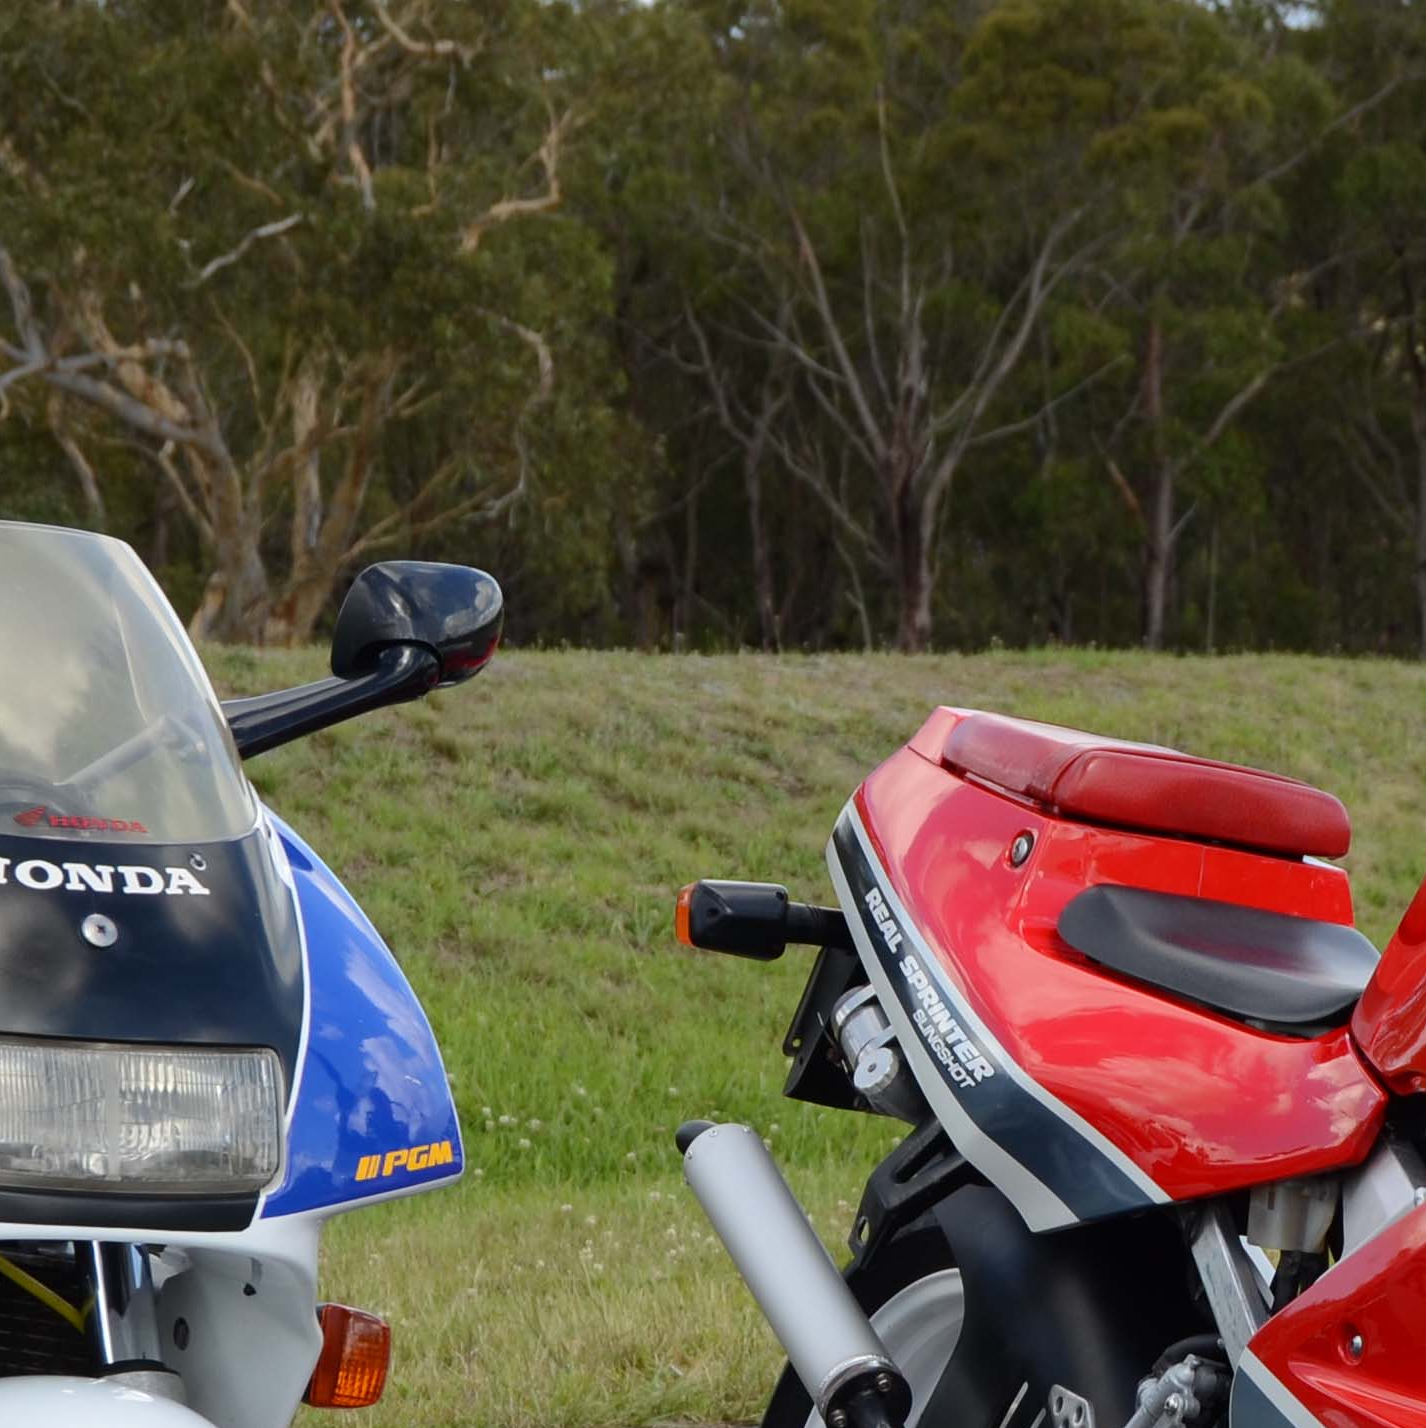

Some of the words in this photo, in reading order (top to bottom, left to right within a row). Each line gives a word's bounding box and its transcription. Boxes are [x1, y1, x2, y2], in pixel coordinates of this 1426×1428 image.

[47, 814, 149, 834] HONDA
[865, 887, 904, 955] REAL
[899, 954, 995, 1083] SPRINTER
[912, 1008, 976, 1089] SLINGSHOT
